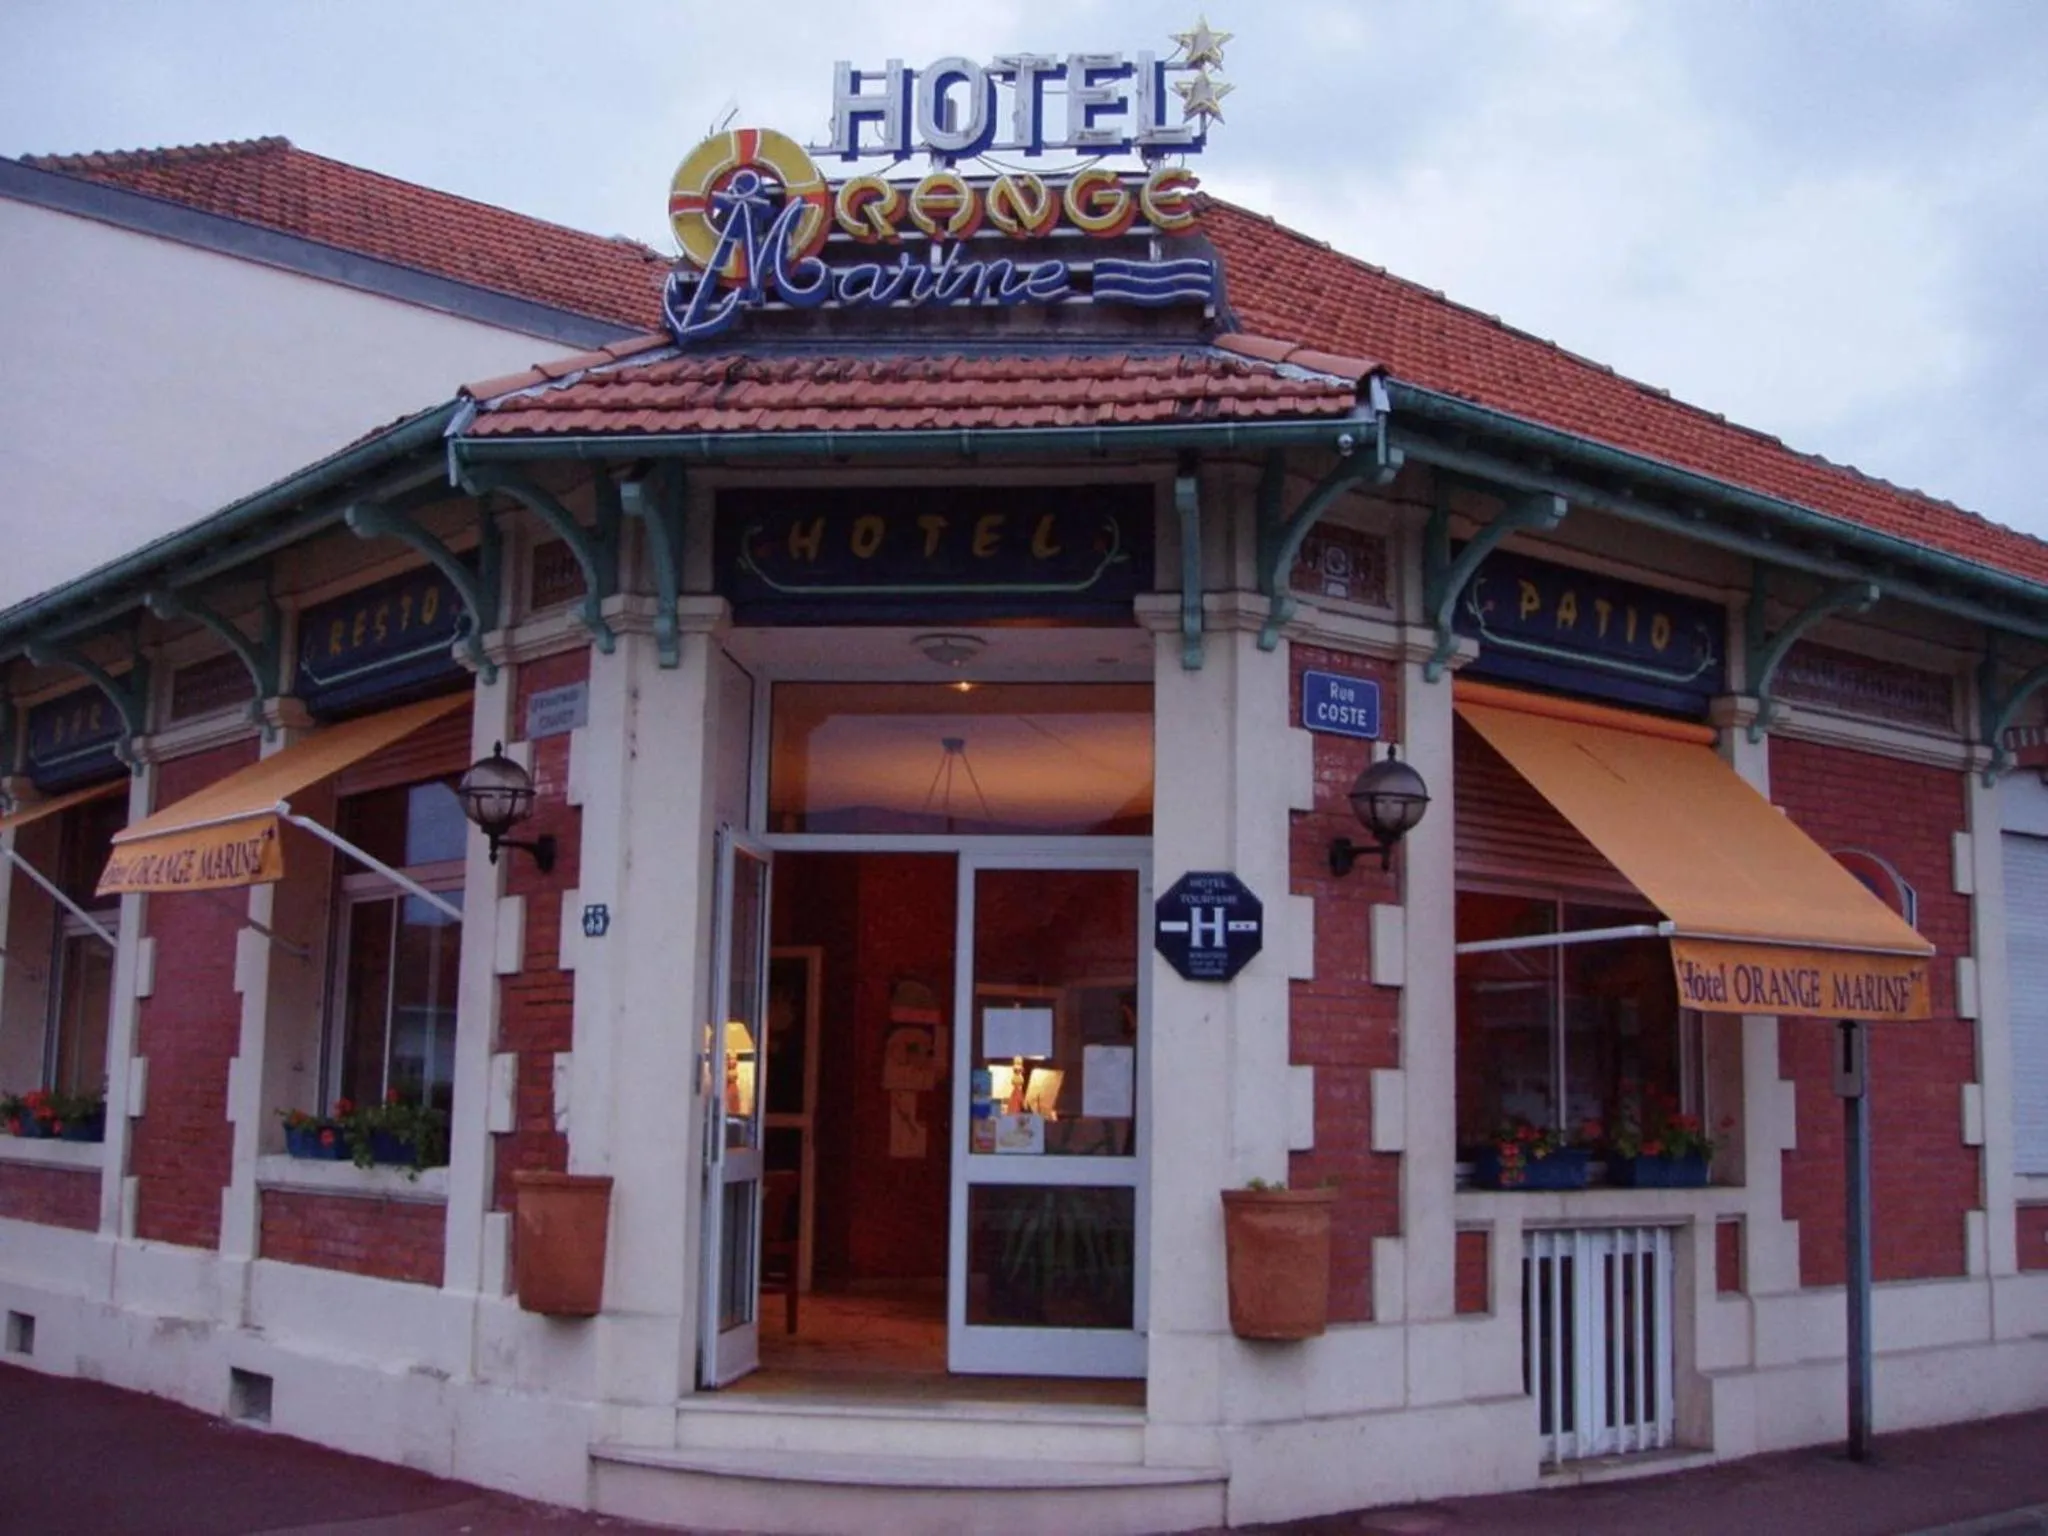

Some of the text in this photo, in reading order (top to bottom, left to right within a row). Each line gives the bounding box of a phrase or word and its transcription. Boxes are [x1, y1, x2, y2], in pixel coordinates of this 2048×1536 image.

[831, 51, 1207, 161] HOTEL
[664, 169, 1070, 345] Marine
[788, 514, 1062, 562] HOTEL
[329, 586, 440, 657] RESTO
[1517, 579, 1671, 651] PATIO
[1317, 702, 1368, 728] COSTE
[196, 838, 263, 883] MARINE
[1190, 906, 1226, 949] H
[1733, 963, 1821, 1008] ORANGE
[1832, 972, 1911, 1013] MARINE
